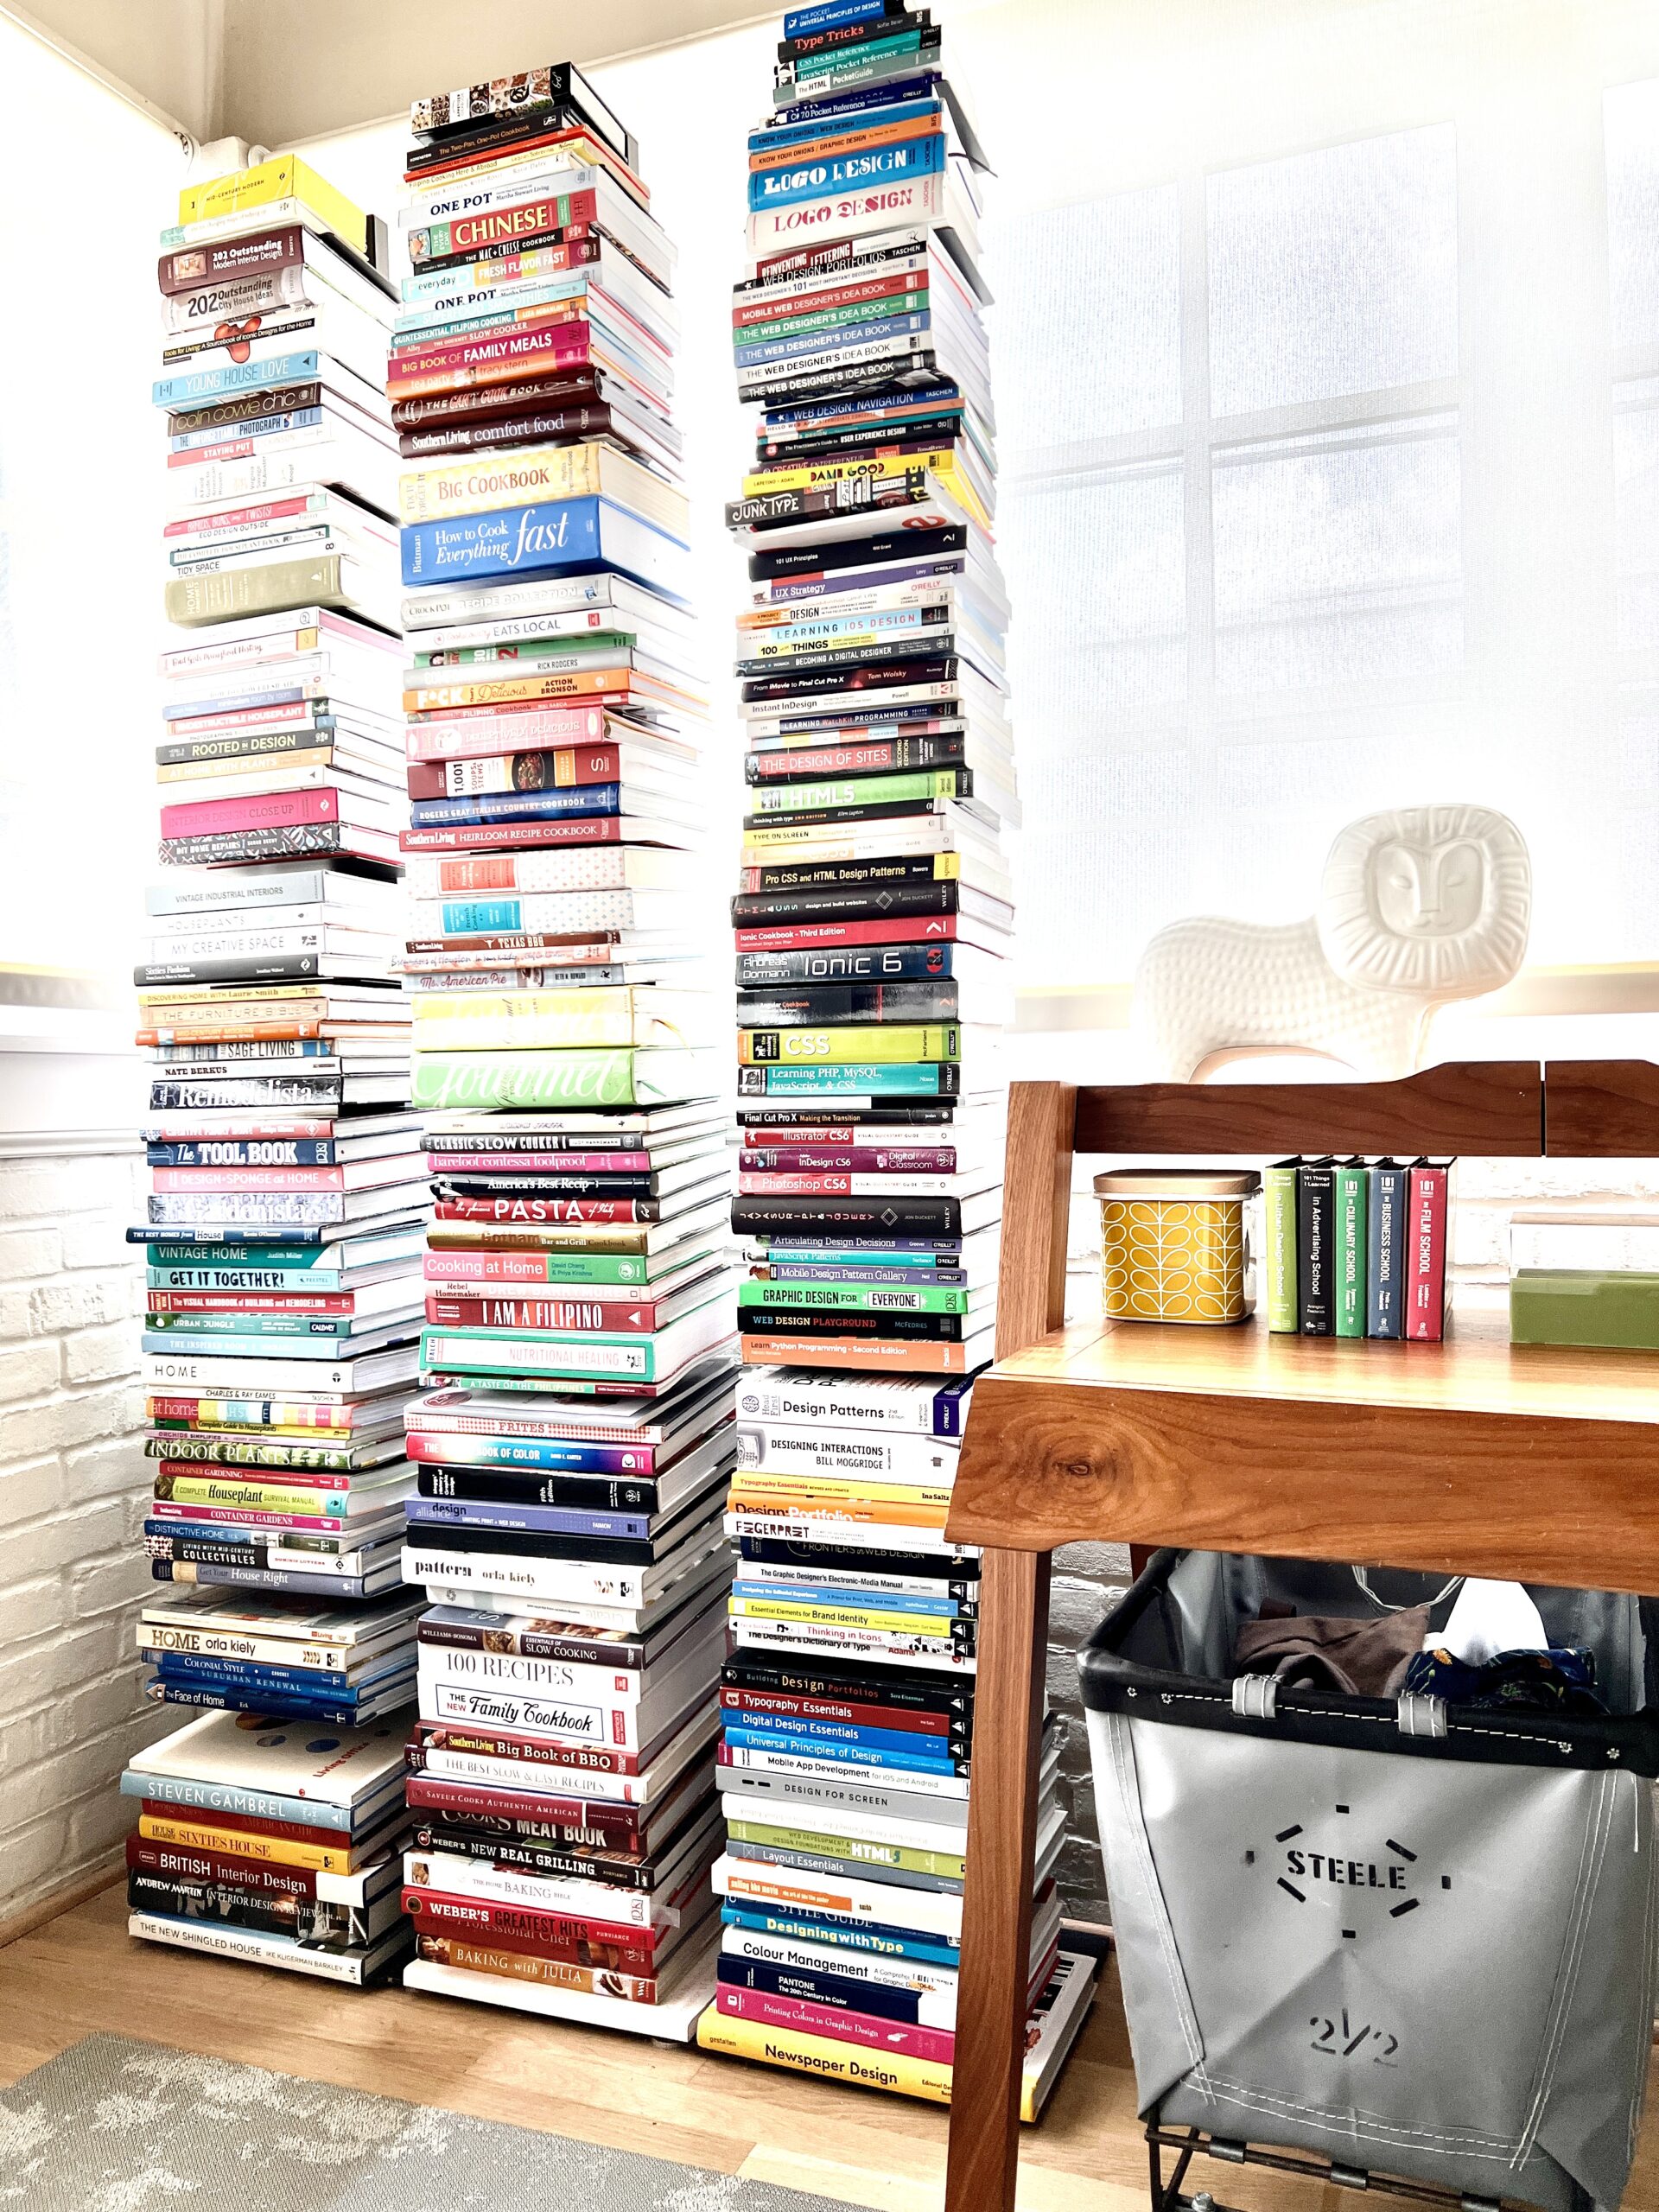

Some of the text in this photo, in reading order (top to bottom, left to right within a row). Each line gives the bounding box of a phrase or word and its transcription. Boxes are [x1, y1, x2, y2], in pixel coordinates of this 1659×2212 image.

[795, 26, 864, 49] Type Tricks
[765, 149, 906, 194] LOGO DESIGN
[430, 192, 493, 216] ONE POT
[774, 188, 912, 232] LOGO DESIGN
[456, 204, 548, 245] CHINESE
[213, 240, 282, 262] 202 Outstanding
[479, 251, 564, 279] FRESH FLAVOR FAST
[188, 279, 272, 317] 202 Outstanding
[742, 283, 885, 320] MOBILE WEB DESIGNER'S IDEA BOOK
[401, 334, 551, 372] BIG BOOK OF FAMILY MEALS
[186, 359, 289, 392] YOUNG HOUSE LOVE
[176, 391, 295, 429] colin cowie chic
[794, 393, 913, 420] WEB DESIGN: NAVIGATION
[733, 493, 799, 521] JUNK TYPE
[435, 524, 508, 544] How to Cook
[508, 510, 569, 565] fast
[413, 534, 422, 573] Bittman
[435, 541, 512, 563] Everything
[177, 562, 219, 575] TIDY SPACE
[775, 584, 825, 598] UX Strategy
[192, 741, 239, 756] ROOTED
[251, 735, 296, 752] DESIGN
[764, 749, 887, 772] THE DESIGN OF SITES
[790, 785, 855, 808] HTML5
[766, 875, 779, 884] Pro
[781, 874, 798, 882] CSS
[814, 872, 836, 880] HTML
[839, 868, 868, 879] Design
[870, 866, 906, 876] Patterns
[175, 887, 283, 903] VINTAGE INDUSTRIAL INTERIORS
[498, 937, 544, 949] TEXAS BBQ
[804, 952, 901, 976] Ionic 6
[785, 1036, 830, 1056] CSS
[177, 1142, 297, 1165] The TOOL BOOK
[762, 1179, 847, 1192] Photoshop CS6
[494, 1200, 584, 1220] PASTA
[1313, 1207, 1321, 1260] Advertising
[1346, 1207, 1355, 1283] CULINARY SCHOOL
[1381, 1204, 1391, 1283] BUSINESS SCHOOL
[1420, 1210, 1432, 1274] FILM SCHOOL
[159, 1248, 247, 1260] VINTAGE HOME
[170, 1272, 284, 1287] GET IT TOGETHER!
[427, 1260, 543, 1275] Cooking at Home
[1312, 1262, 1320, 1295] School
[764, 1290, 803, 1303] GRAPHIC
[806, 1291, 838, 1304] DESIGN
[872, 1294, 916, 1306] EVERYONE
[483, 1301, 603, 1329] I AM A FILIPINO
[156, 1366, 196, 1377] HOME
[783, 1402, 885, 1419] Design Patterns
[499, 1422, 544, 1433] FRITES
[771, 1440, 883, 1456] DESIGNING INTERACTIONS
[816, 1457, 883, 1469] BILL MOGGRIDGE
[209, 1485, 262, 1503] Houseplant
[415, 1561, 535, 1586] pattern orla kiely
[152, 1630, 256, 1656] HOME orla kiely
[526, 1643, 596, 1660] SLOW COOKING
[447, 1653, 574, 1686] 100 RECIPES
[448, 1702, 467, 1712] NEW
[449, 1694, 466, 1702] THE
[470, 1694, 593, 1732] Family Cookbook
[743, 1713, 859, 1738] Digital Design Essentials
[149, 1783, 285, 1816] STEVEN GAMBREL
[785, 1784, 888, 1806] DESIGN FOR SCREEN
[180, 1831, 270, 1857] SIXTIES HOUSE
[432, 1838, 594, 1875] WEBER'S NEW REAL GRILLING
[763, 1851, 844, 1872] Layout Essentials
[161, 1854, 306, 1894] BRITISH Interior Design
[1287, 1850, 1406, 1890] STEELE
[429, 1903, 588, 1939] WEBER'S GREATEST HITS
[140, 1923, 261, 1956] THE NEW SHINGLED HOUSE
[456, 1949, 508, 1968] BAKING
[542, 1967, 582, 1982] JULIA
[743, 1942, 868, 1977] Colour Management
[766, 2044, 897, 2084] Newspaper Design
